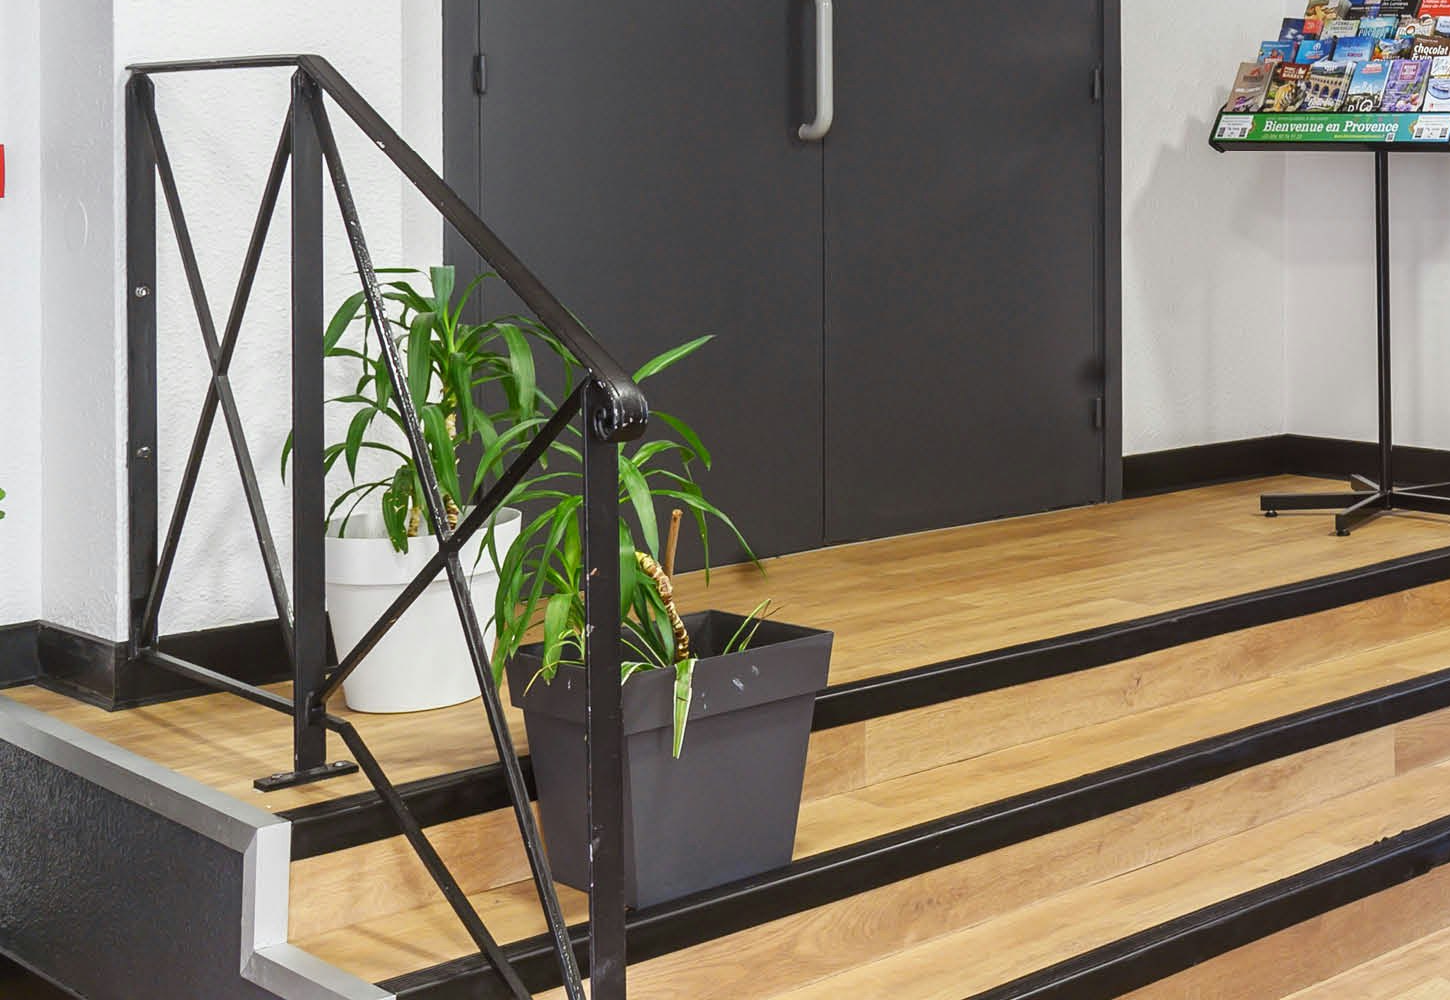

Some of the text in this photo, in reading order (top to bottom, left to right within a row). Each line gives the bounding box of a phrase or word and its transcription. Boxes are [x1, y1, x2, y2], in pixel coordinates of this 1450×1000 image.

[1413, 42, 1449, 57] chocolat
[1263, 120, 1324, 132] Bienvenue
[1326, 123, 1340, 132] en
[1343, 121, 1399, 132] Provence
